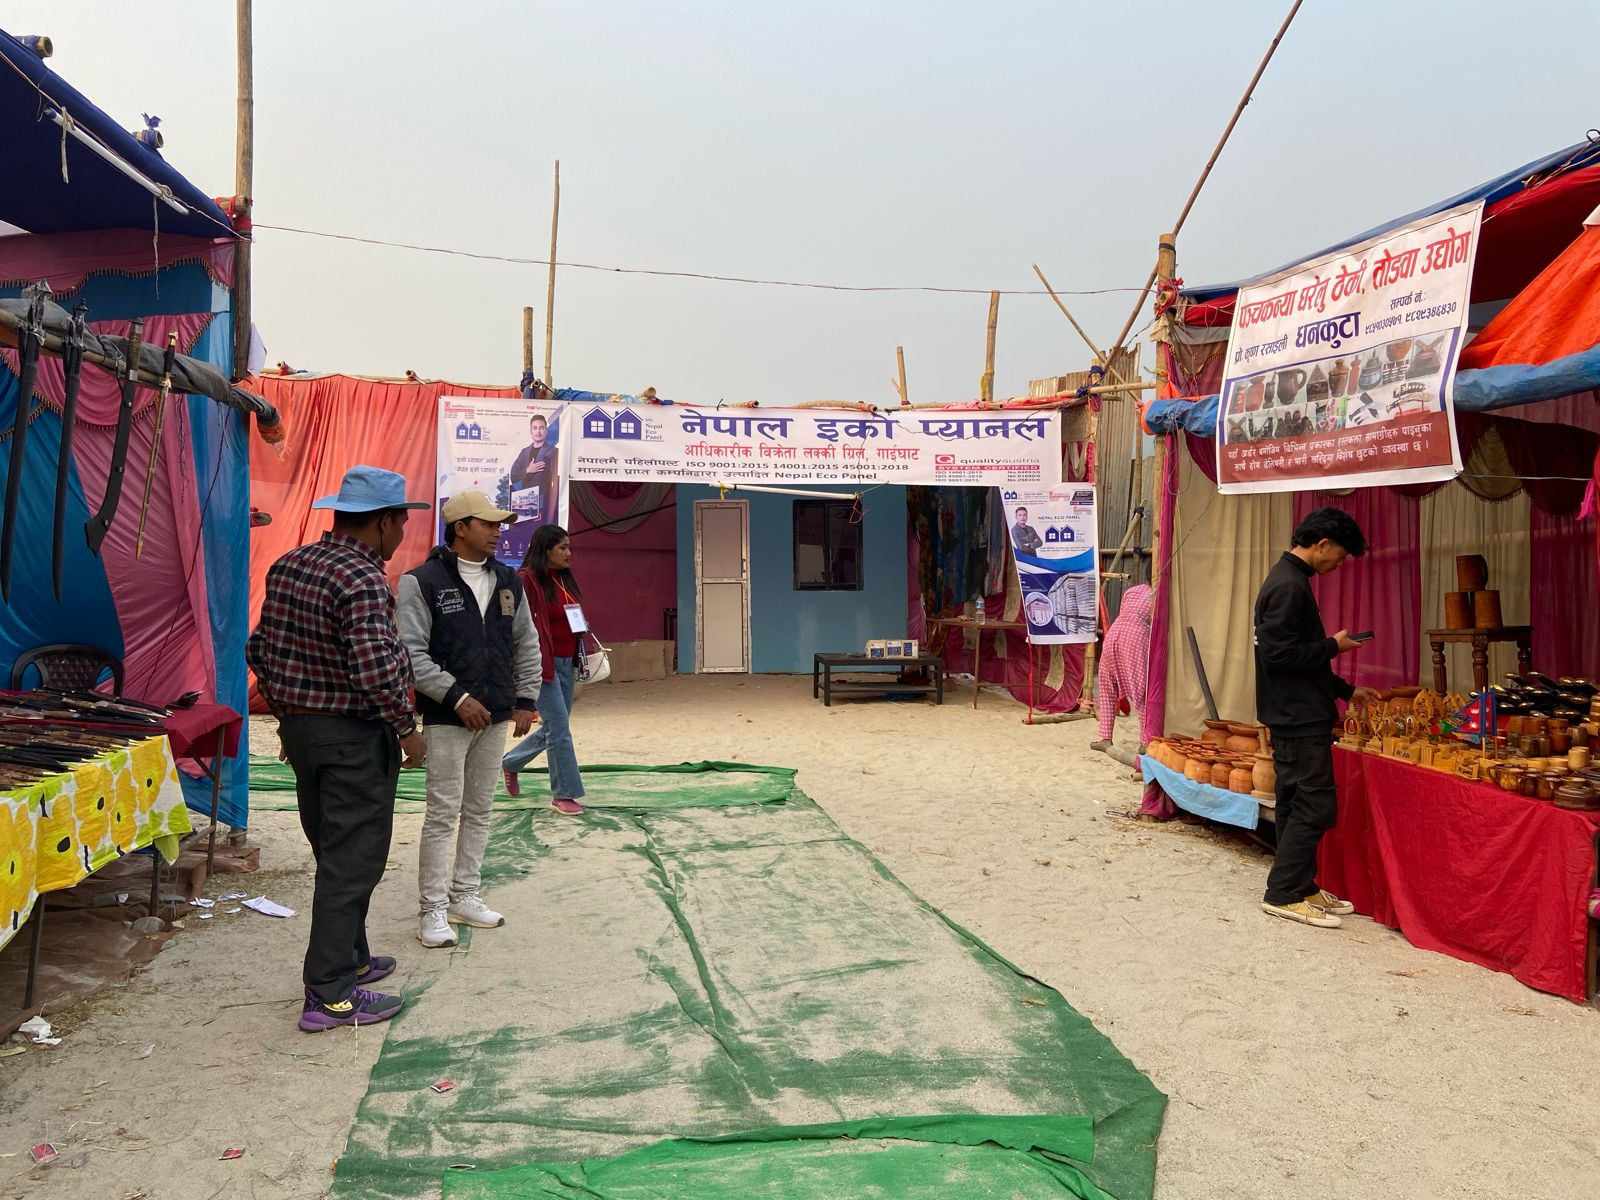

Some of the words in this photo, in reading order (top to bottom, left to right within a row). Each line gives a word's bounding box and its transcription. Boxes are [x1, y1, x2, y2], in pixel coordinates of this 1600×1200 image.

[1420, 227, 1472, 274] उद्योग
[1390, 291, 1413, 311] सम्पर्क
[1295, 311, 1361, 349] धनकुटा
[680, 408, 794, 441] नेपाल
[813, 411, 900, 442] इको
[919, 417, 1052, 442] प्यानल
[759, 442, 797, 459] विक्रेता
[803, 443, 836, 459] लक्की
[709, 461, 769, 469] 9001:2015
[841, 463, 910, 471] 45001:2018
[774, 472, 812, 480] Nepal
[816, 472, 838, 480] Eco
[841, 472, 877, 480] Panel
